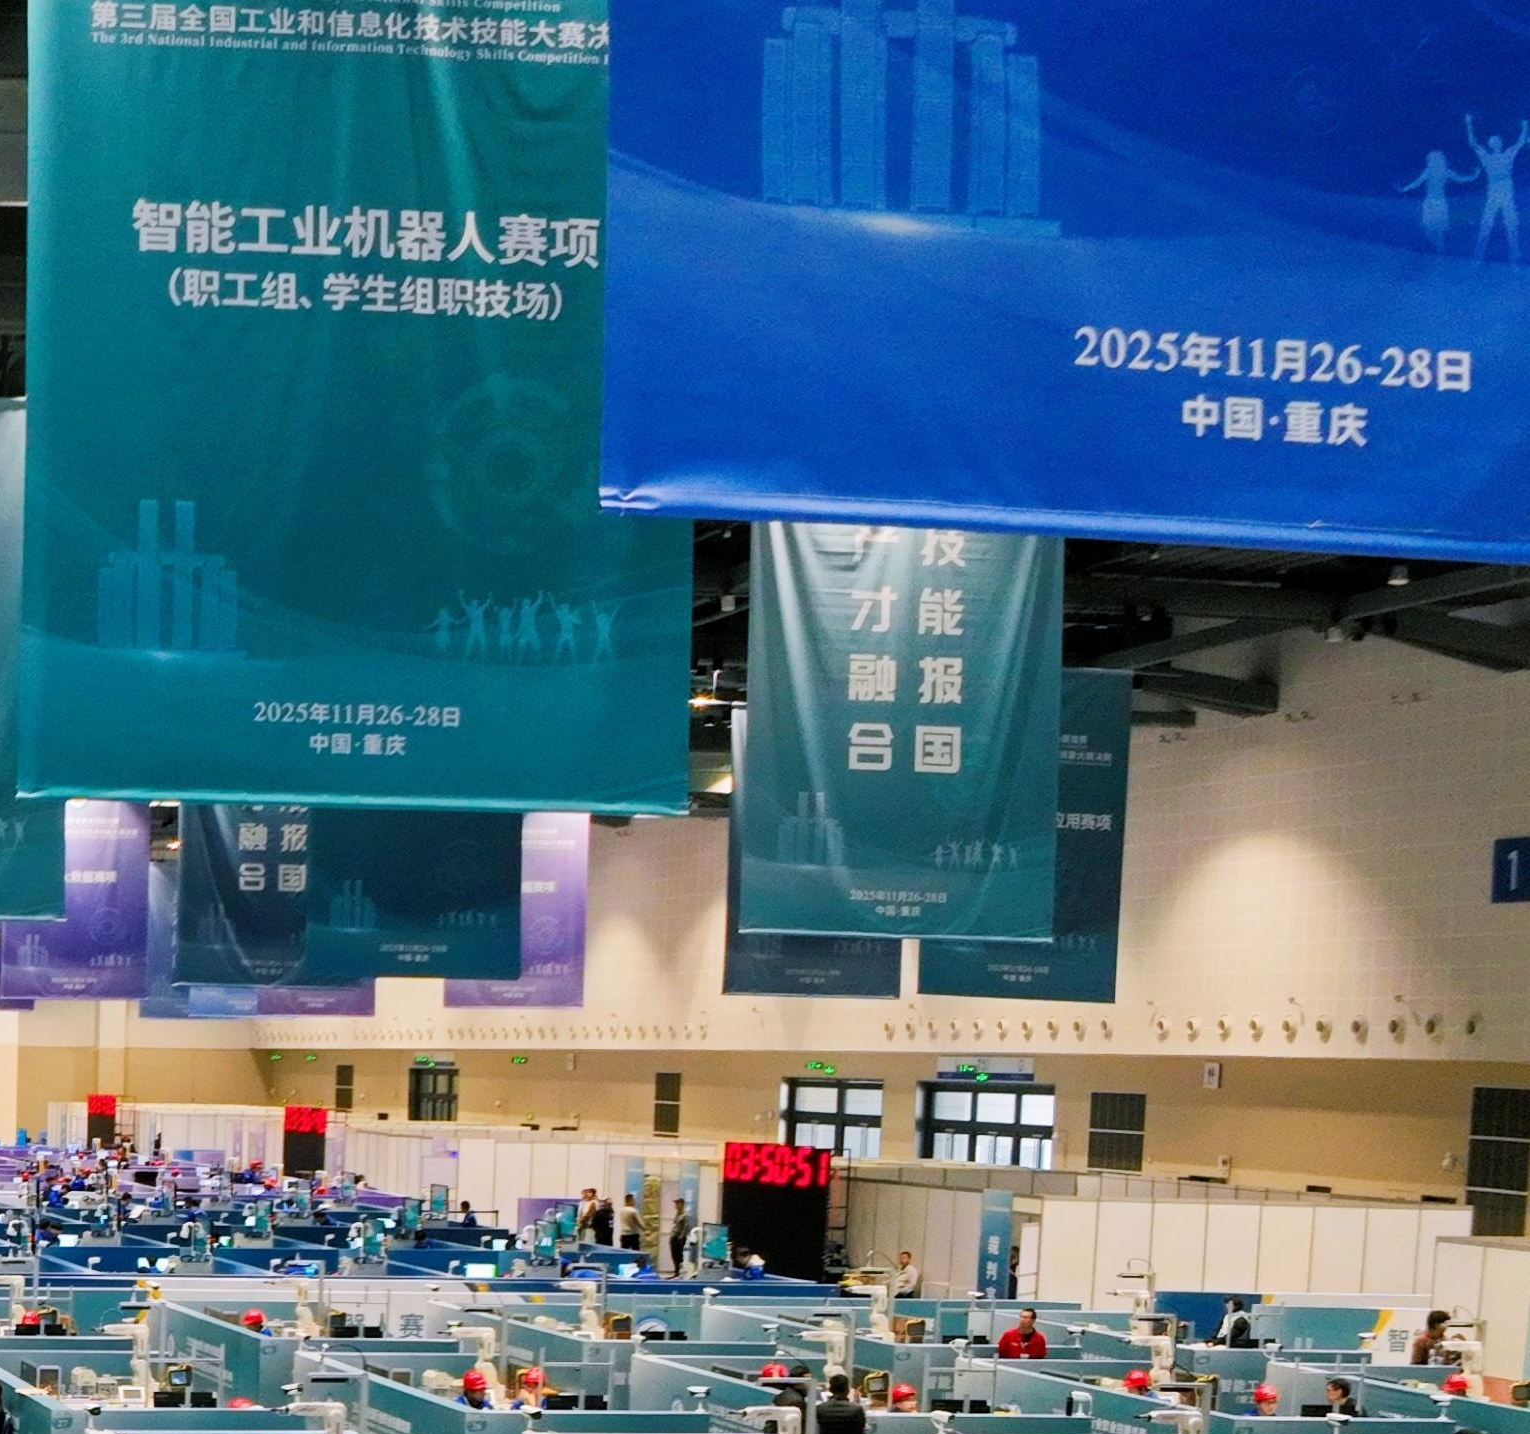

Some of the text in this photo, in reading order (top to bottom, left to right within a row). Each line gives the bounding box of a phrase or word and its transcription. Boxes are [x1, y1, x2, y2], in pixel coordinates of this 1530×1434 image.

[91, 32, 116, 45] The
[120, 34, 144, 45] 3rd
[148, 34, 205, 48] National
[210, 36, 278, 50] Industrial
[282, 39, 307, 51] and
[312, 40, 393, 55] Information
[398, 44, 471, 62] Technology
[476, 48, 515, 61] Skills
[518, 50, 600, 66] Competition
[132, 198, 601, 270] 智能工业机器人赛项
[1074, 325, 1473, 394] 2025年11月26-28日
[1181, 396, 1370, 448] 中国·重庆
[253, 701, 461, 729] 2025年11月26-28日
[309, 732, 406, 757] 中国·重庆
